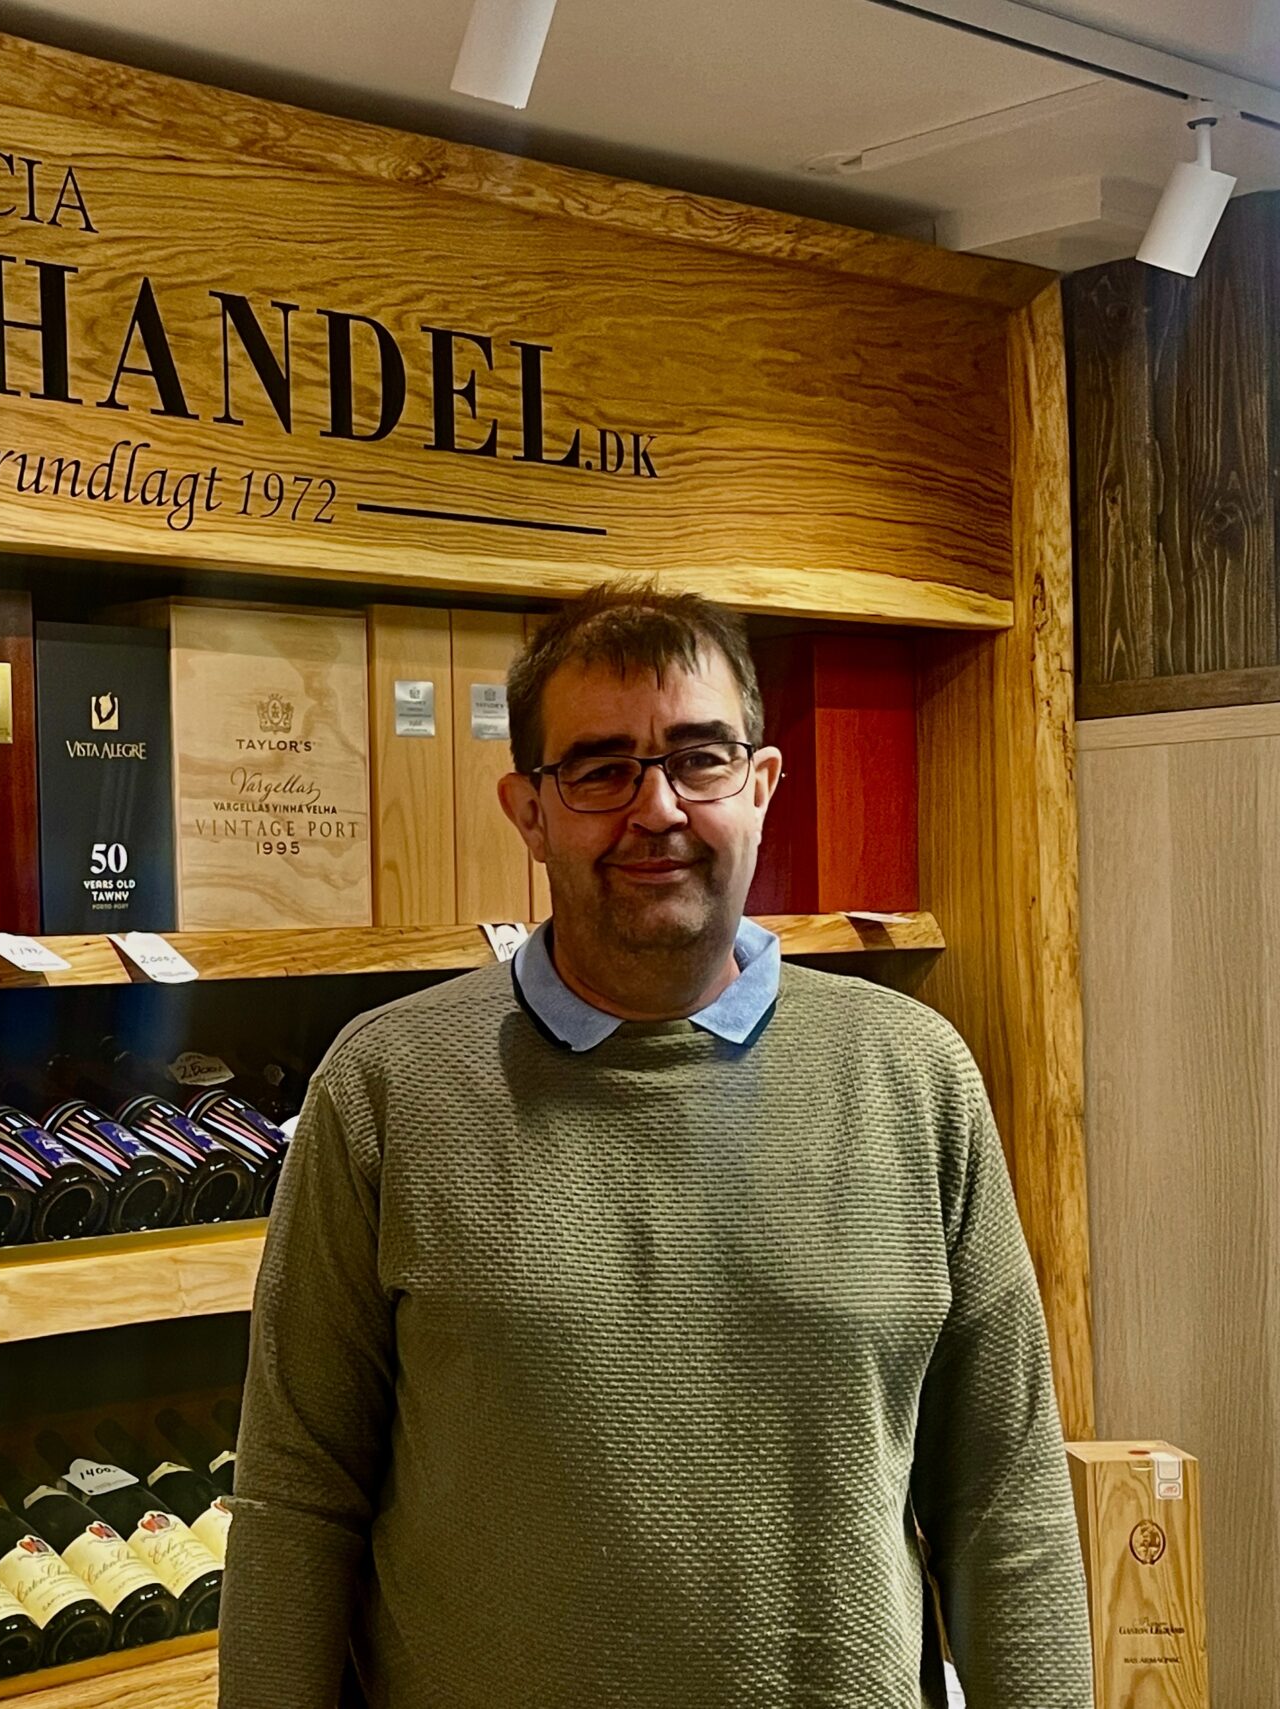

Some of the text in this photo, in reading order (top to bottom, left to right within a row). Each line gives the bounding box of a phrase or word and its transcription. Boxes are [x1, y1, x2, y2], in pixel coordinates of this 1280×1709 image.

[236, 470, 337, 524] 1972
[66, 740, 147, 760] VISTA ALEGRE
[236, 739, 313, 753] TAYLOR'S
[231, 766, 321, 806] Vargellas
[213, 802, 337, 814] VARGELLAS VINHA VELHA
[195, 819, 360, 838] VINTAGE PORT
[257, 841, 300, 855] 1995
[90, 843, 128, 874] 50
[83, 880, 136, 890] YEARS OLD
[92, 891, 130, 902] TAWNY
